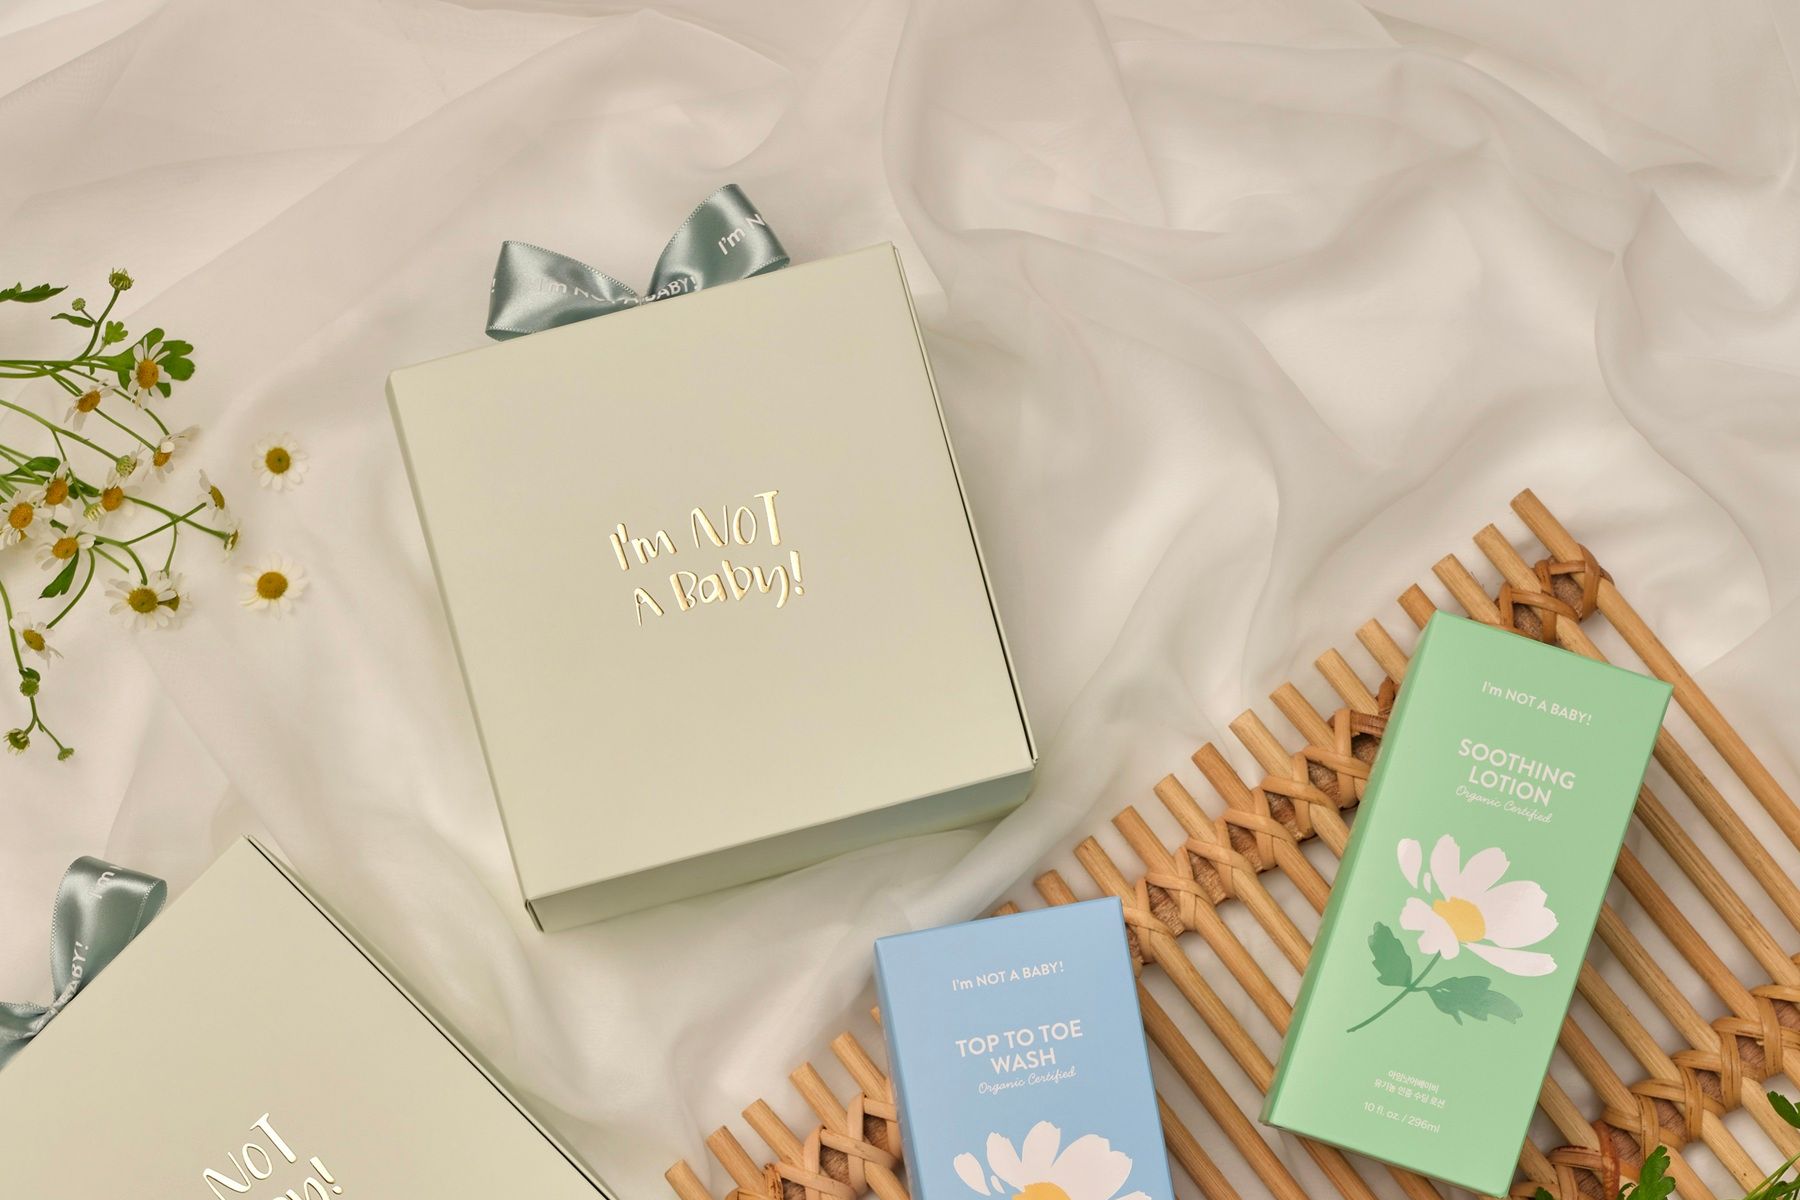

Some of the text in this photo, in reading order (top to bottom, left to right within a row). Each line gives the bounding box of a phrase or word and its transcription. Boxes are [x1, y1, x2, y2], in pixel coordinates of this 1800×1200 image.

[718, 227, 747, 256] I'm
[609, 490, 781, 571] I'm NOT
[633, 550, 805, 627] A Baby!
[1481, 680, 1592, 726] I'm NOT A BABY!
[1458, 738, 1576, 790] SOOTHING
[1455, 785, 1553, 824] Organic Certified
[1468, 765, 1552, 807] LOTION
[952, 961, 1064, 991] I'm NOT A BABY!
[955, 1019, 1083, 1057] TOP TO TOE
[990, 1047, 1056, 1074] WASH
[978, 1065, 1077, 1095] Organic Certified
[1363, 1102, 1375, 1112] 10
[1407, 1115, 1440, 1133] 296ml
